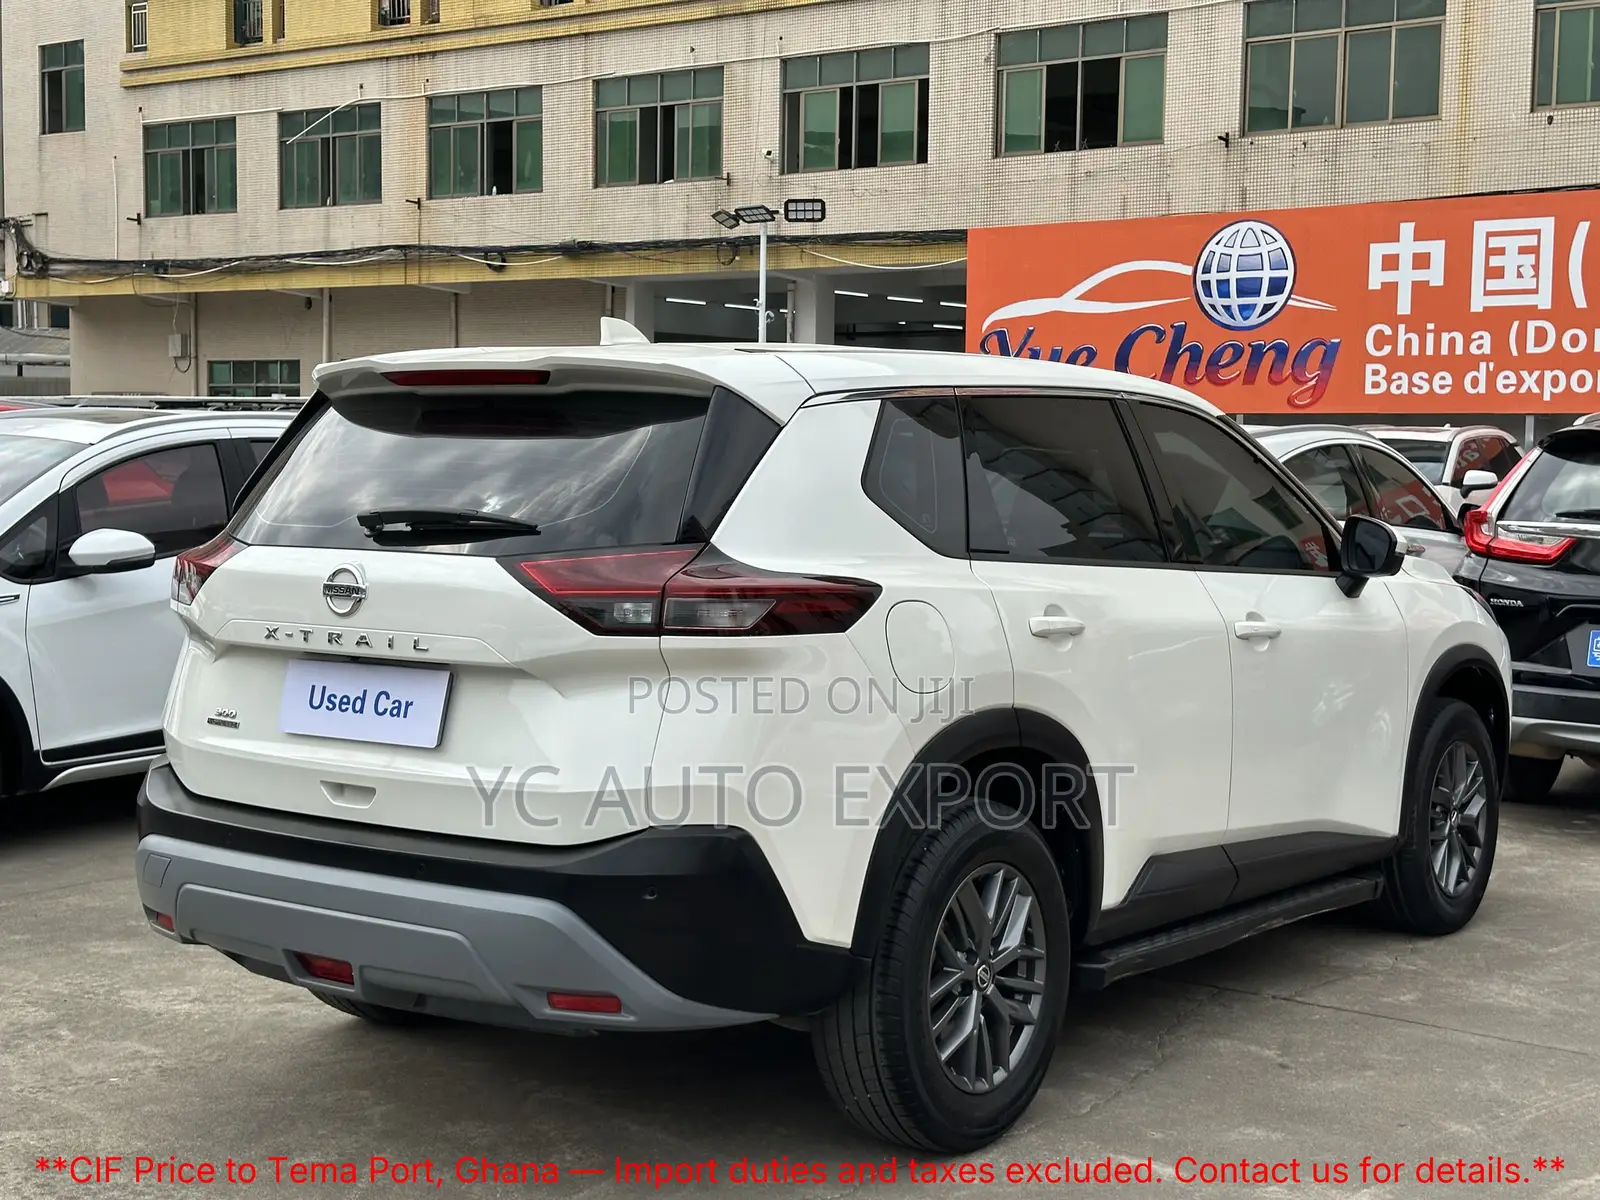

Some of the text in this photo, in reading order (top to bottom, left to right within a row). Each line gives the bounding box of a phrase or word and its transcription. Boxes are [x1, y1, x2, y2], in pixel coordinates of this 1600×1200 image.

[1365, 323, 1491, 356] China
[1114, 320, 1342, 409] Cheng
[1364, 361, 1600, 401] Base d'expo
[323, 585, 360, 595] NISSAN
[1490, 598, 1524, 607] HONDA
[264, 625, 429, 652] X-TRAIL
[308, 684, 414, 719] Used Car
